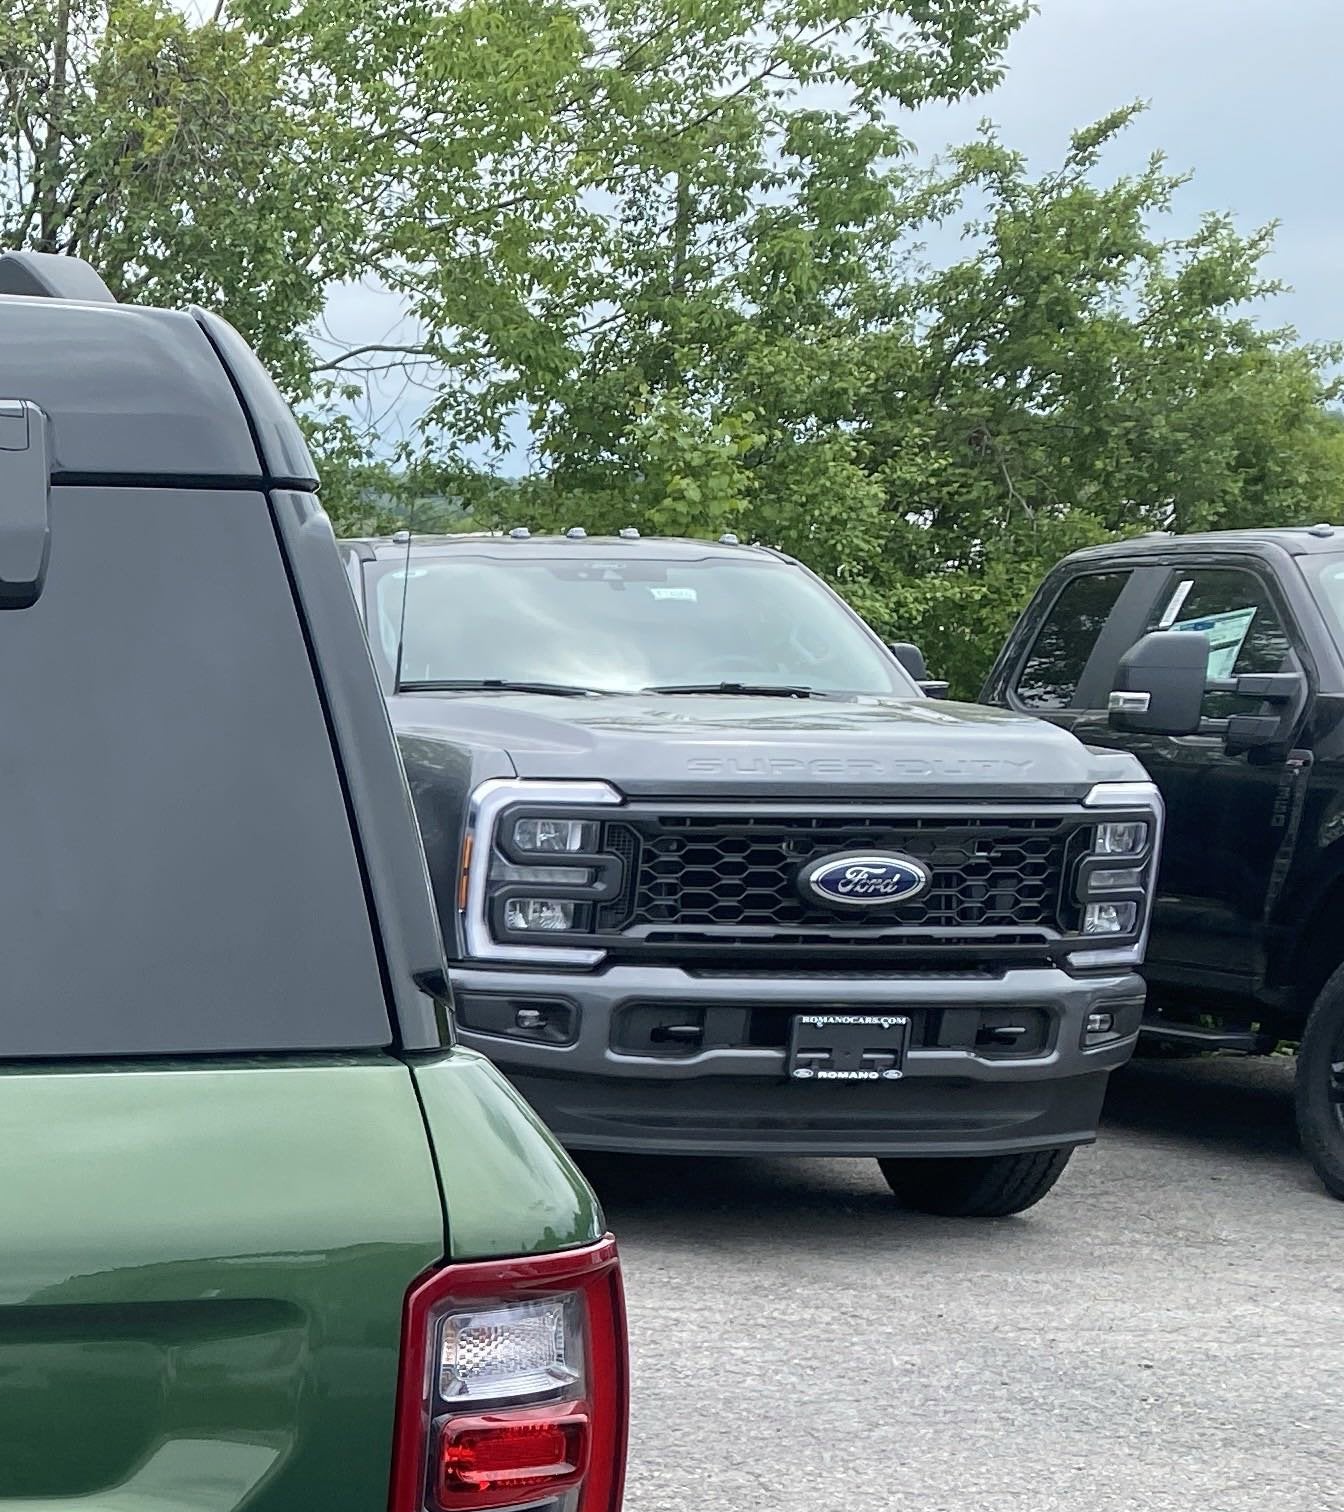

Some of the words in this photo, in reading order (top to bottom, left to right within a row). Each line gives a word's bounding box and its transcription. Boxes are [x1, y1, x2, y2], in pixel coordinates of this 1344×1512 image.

[687, 757, 885, 775] SUPER
[893, 758, 1034, 776] DUTY
[838, 866, 901, 894] Ford
[802, 1016, 907, 1026] ROMANOCARS.COM
[817, 1071, 880, 1080] ROMANO
